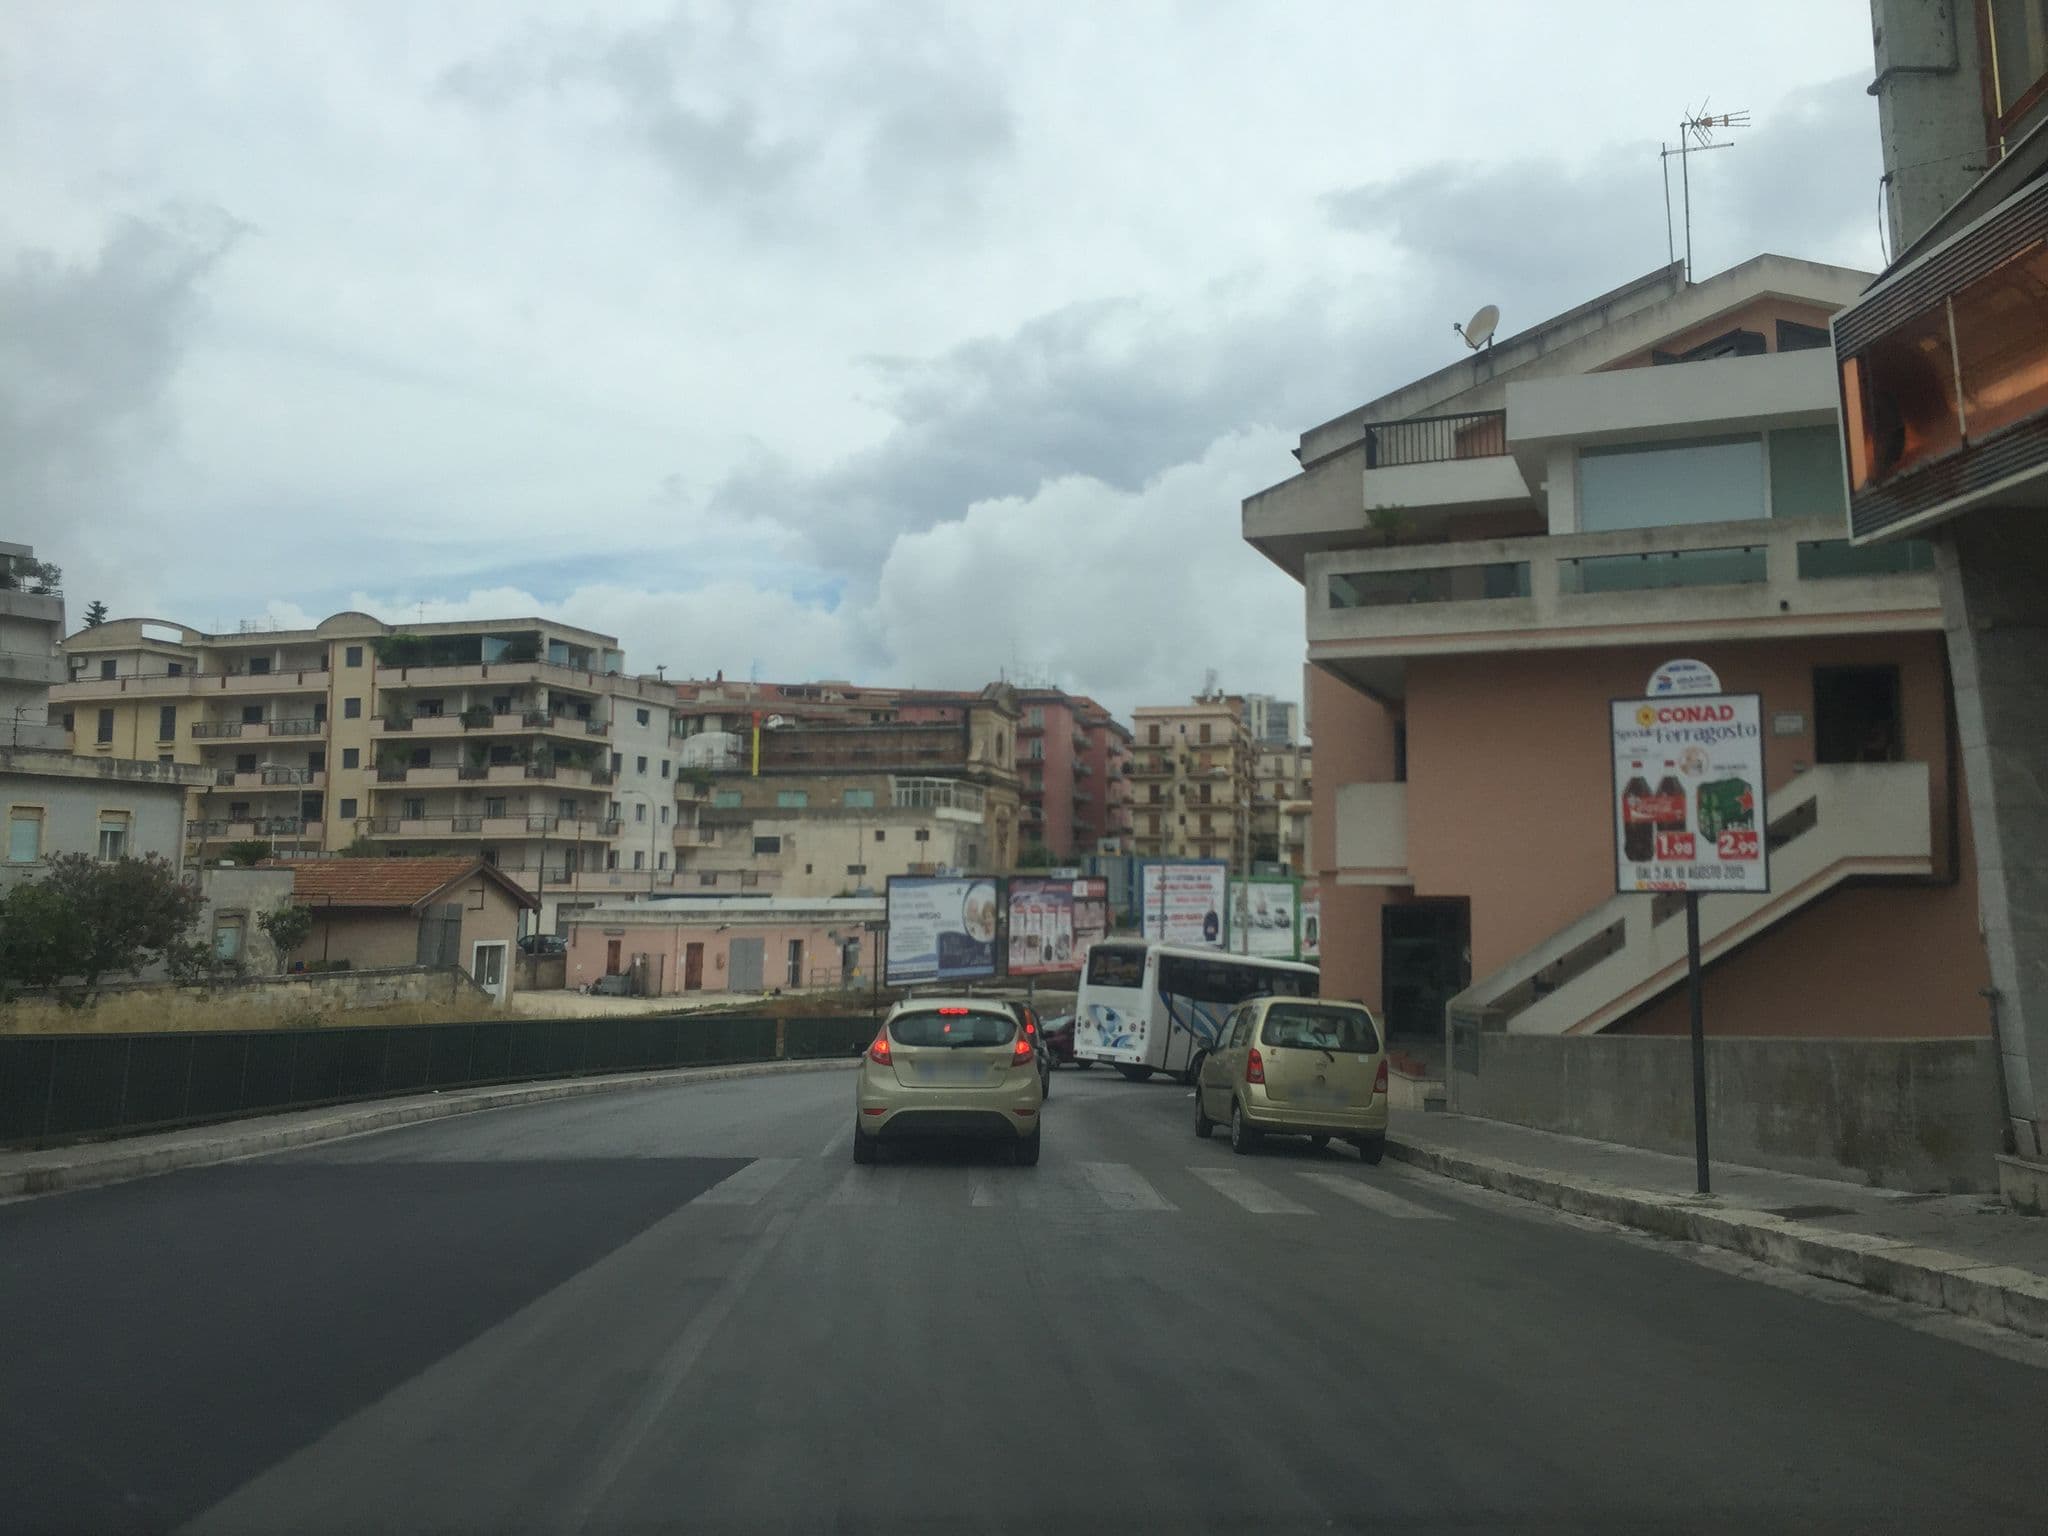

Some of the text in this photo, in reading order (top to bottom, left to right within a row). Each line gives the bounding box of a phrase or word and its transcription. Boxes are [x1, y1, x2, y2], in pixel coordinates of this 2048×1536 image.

[1658, 704, 1734, 723] CONAD
[1656, 721, 1757, 744] Ferragosto
[1720, 834, 1758, 856] 2.99
[1688, 864, 1721, 880] AGOSTO
